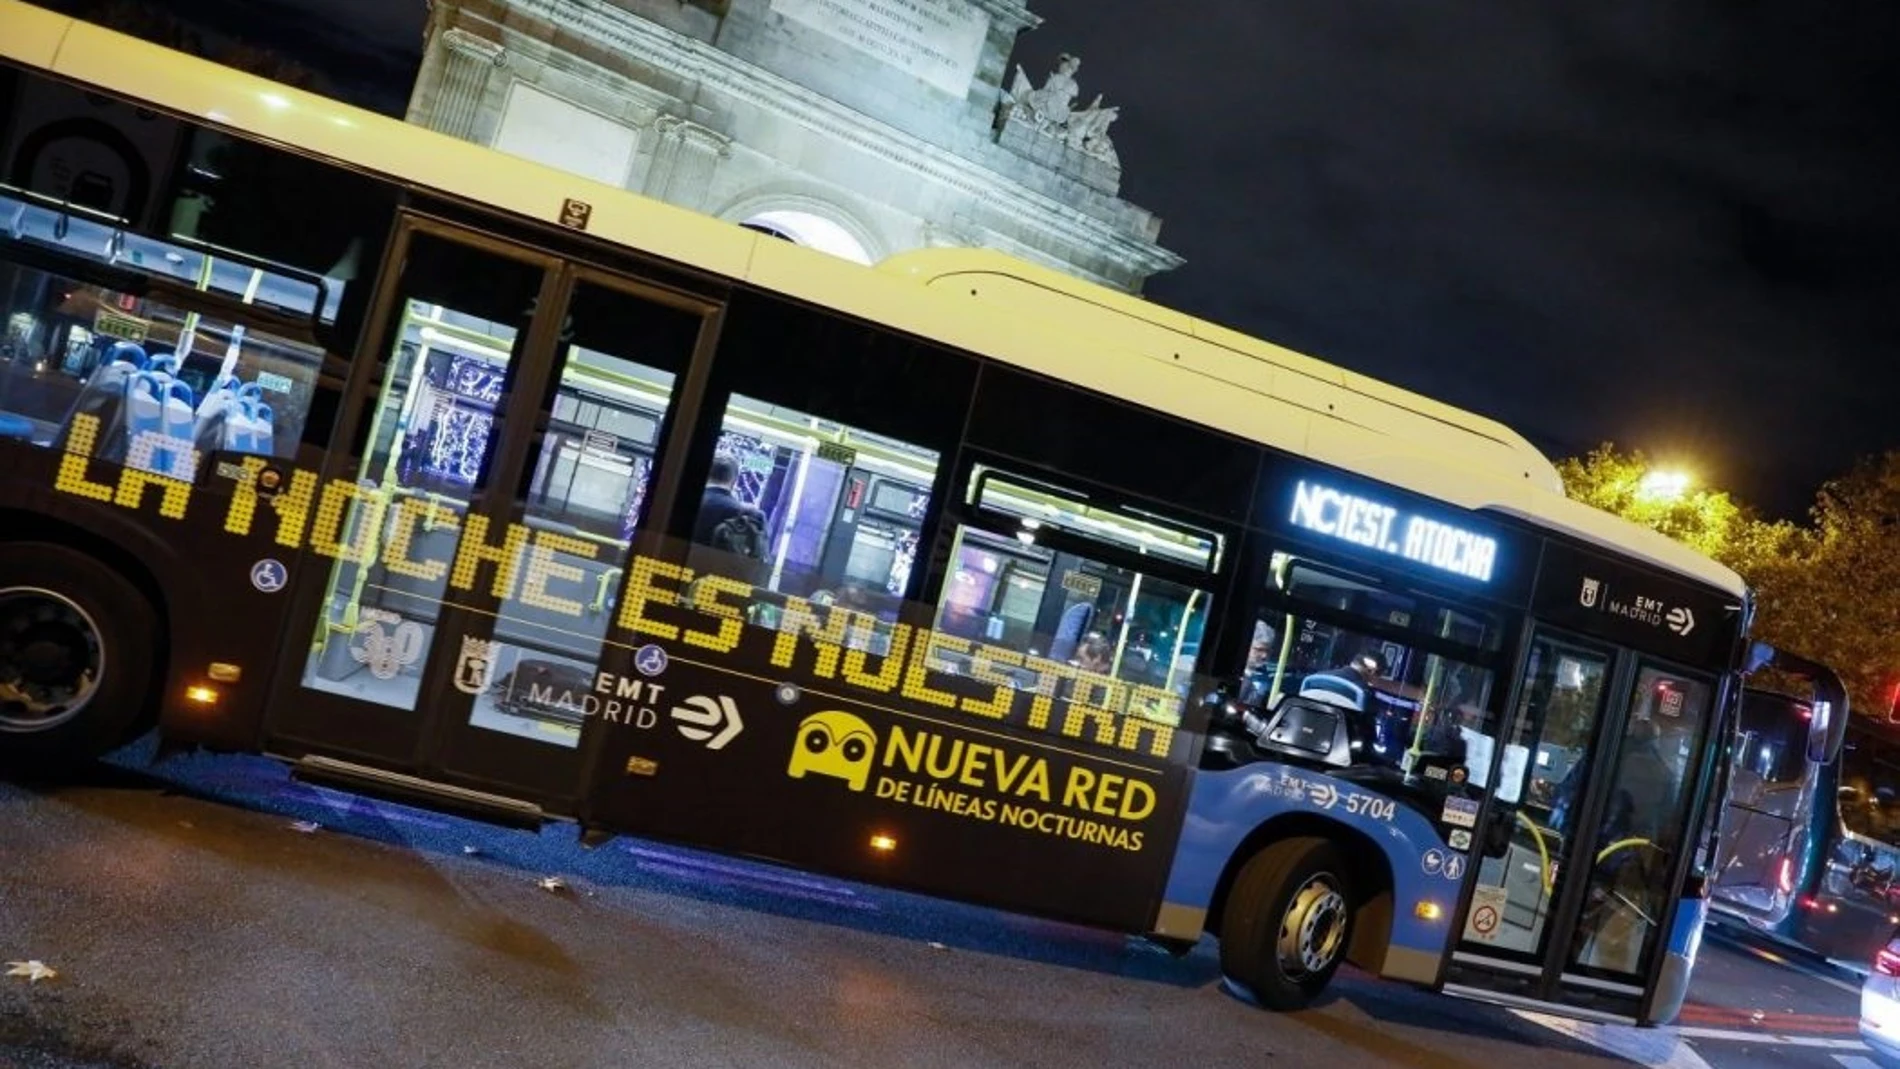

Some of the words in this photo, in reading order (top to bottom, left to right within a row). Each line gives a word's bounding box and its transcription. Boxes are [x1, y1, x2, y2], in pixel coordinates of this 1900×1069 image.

[1403, 515, 1497, 582] ATOCHA
[54, 412, 201, 519] LA
[224, 456, 599, 617] NOCHE
[617, 555, 751, 653] ES
[770, 595, 1180, 758] NUESTRA
[1635, 595, 1664, 613] EMT
[1609, 600, 1662, 626] MADRID
[527, 682, 657, 730] MADRID
[596, 671, 666, 704] EMT
[882, 725, 1050, 801] NUEVA
[1062, 767, 1157, 821] RED
[1280, 775, 1308, 790] EMT
[876, 776, 909, 803] DE
[914, 781, 997, 821] LÍNEAS
[999, 807, 1145, 852] NOCTURNAS
[1346, 792, 1397, 822] 5704
